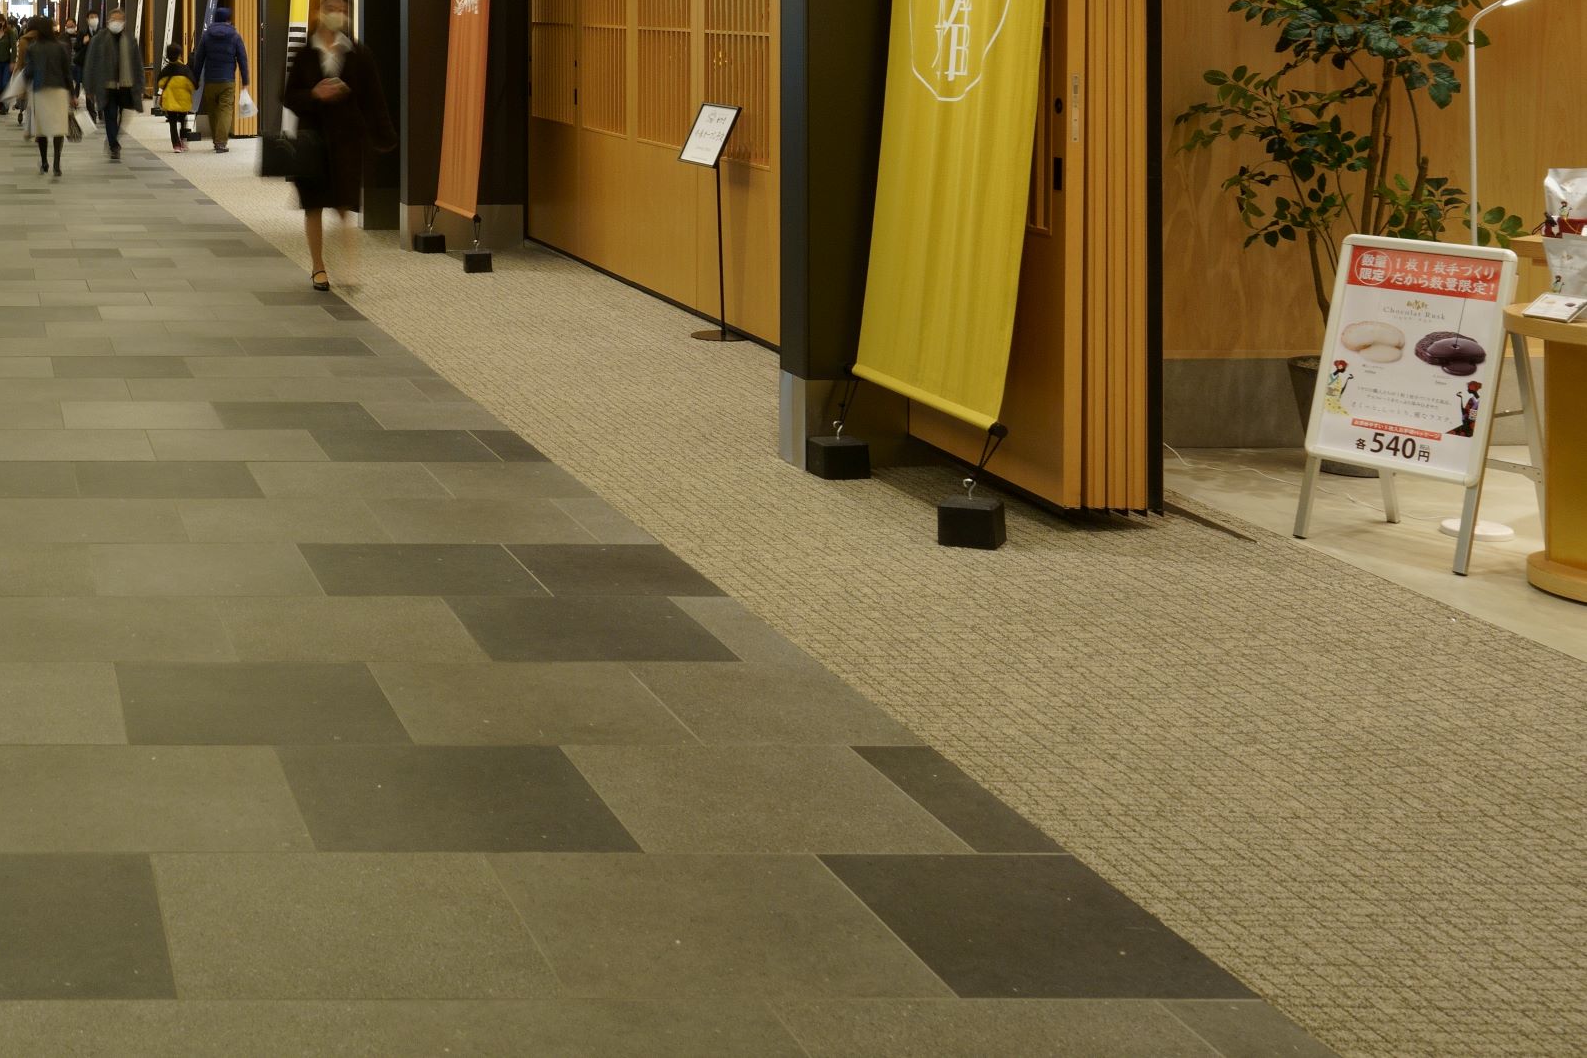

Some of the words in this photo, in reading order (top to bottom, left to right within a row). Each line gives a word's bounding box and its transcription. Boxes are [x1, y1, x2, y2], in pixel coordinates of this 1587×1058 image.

[1361, 253, 1389, 269] 数量
[1358, 267, 1386, 282] 限定
[1382, 306, 1421, 318] Chocolat
[1424, 310, 1446, 321] Rusk
